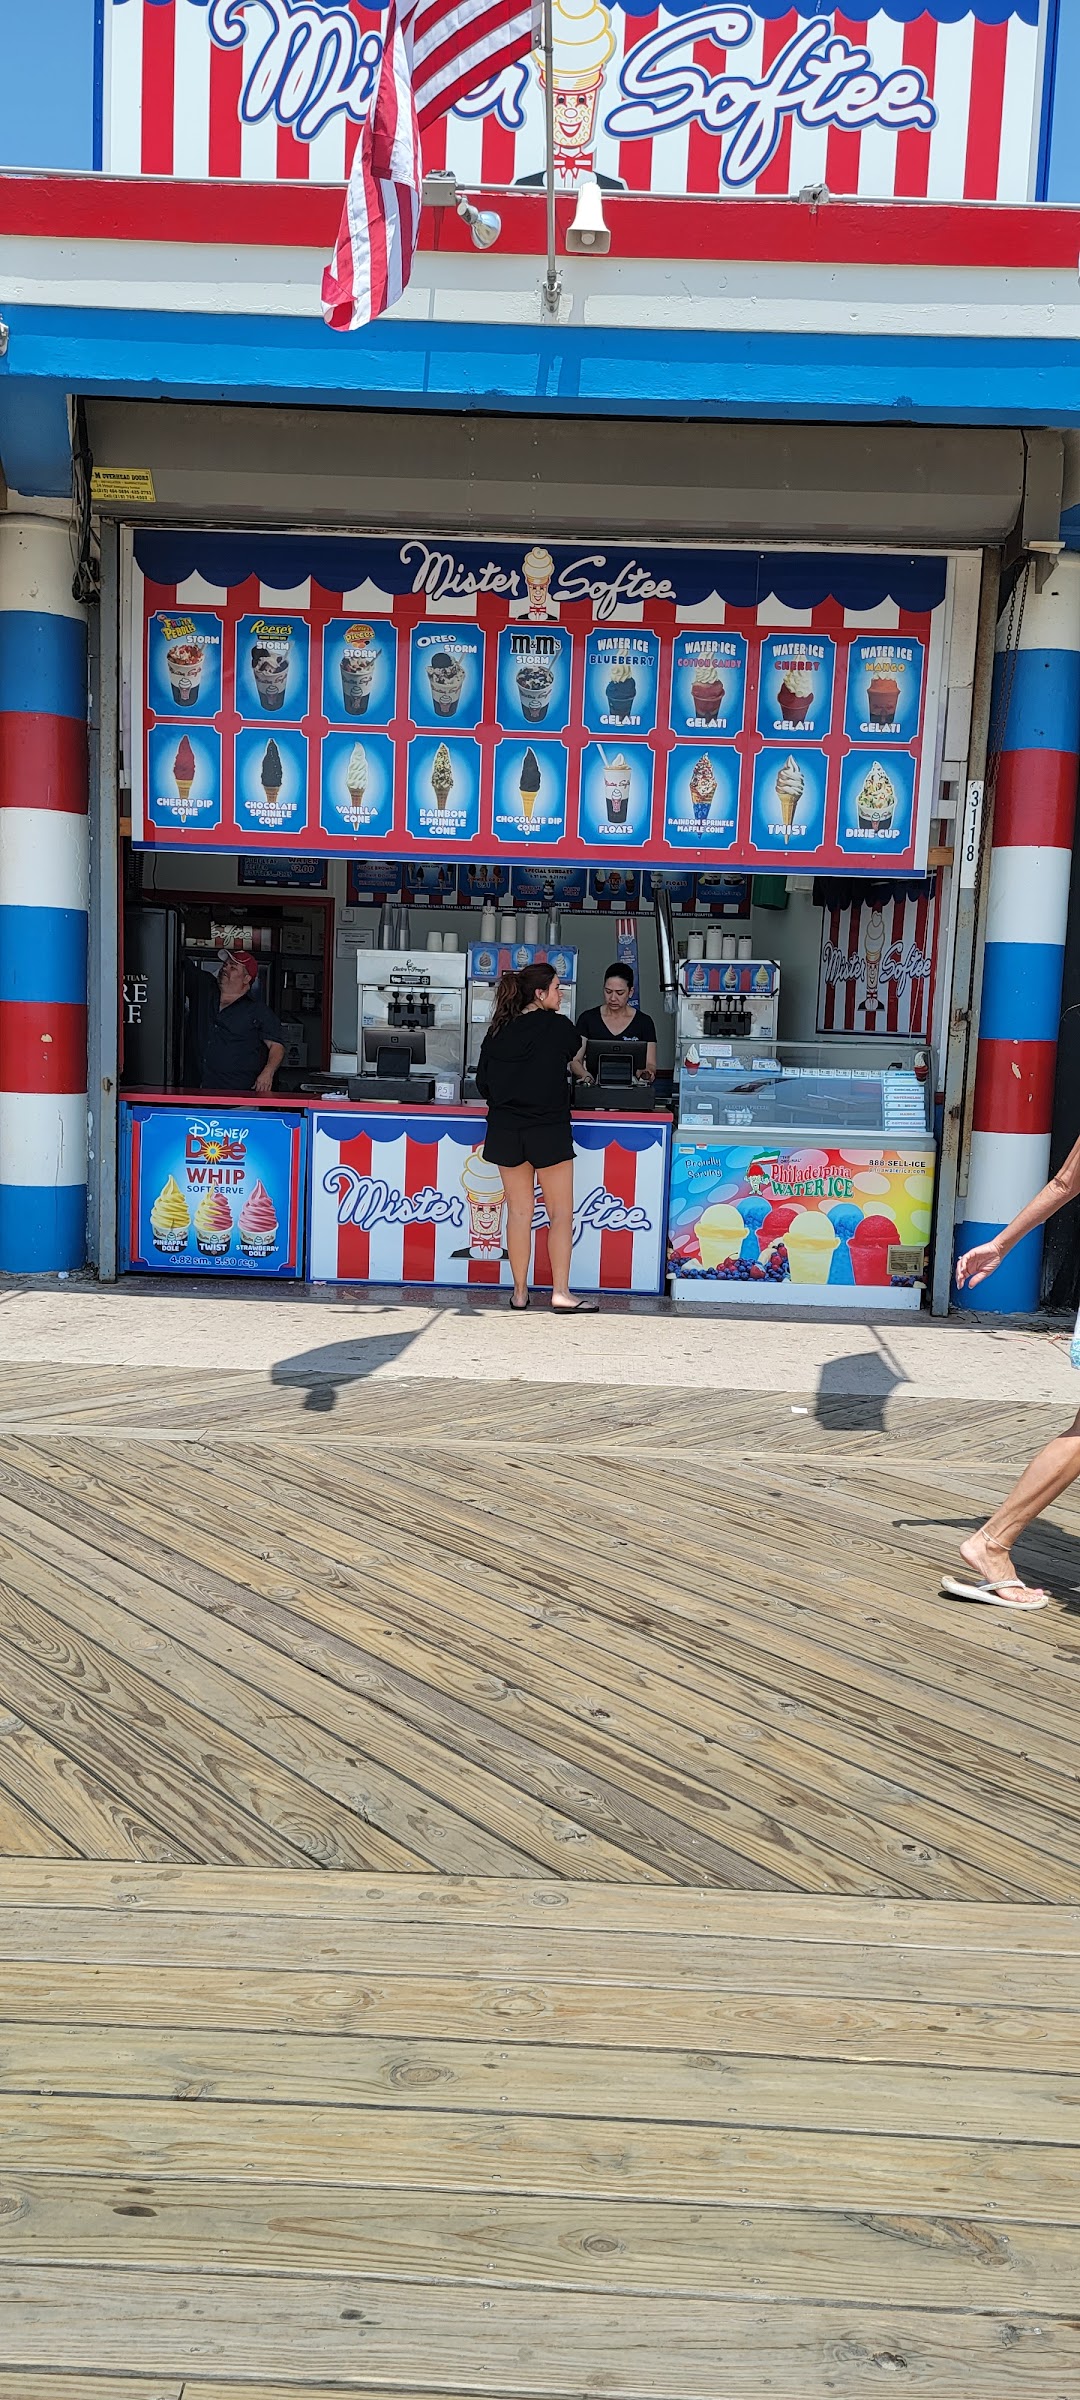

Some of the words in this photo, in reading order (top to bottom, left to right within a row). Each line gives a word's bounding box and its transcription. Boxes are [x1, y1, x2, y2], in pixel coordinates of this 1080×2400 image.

[602, 3, 939, 189] Softee
[400, 540, 520, 601] Mister
[552, 555, 677, 620] Softee
[165, 616, 193, 630] FRUITY
[162, 624, 197, 641] PEBBLES
[186, 635, 219, 644] STORM
[416, 634, 457, 647] OREO
[597, 637, 631, 651] WATER
[632, 639, 649, 653] ICE
[256, 641, 289, 650] STORM
[444, 644, 477, 653] STORM
[685, 641, 719, 655] WATER
[720, 642, 737, 656] ICE
[772, 643, 807, 657] WATER
[808, 644, 825, 658] ICE
[344, 649, 376, 658] STORM
[860, 646, 895, 660] WATER
[896, 647, 913, 661] ICE
[516, 656, 549, 665] STORM
[589, 654, 654, 666] BLUEBERRY
[677, 658, 711, 668] COTTON
[712, 659, 742, 669] CANDY
[774, 660, 821, 671] CHERRY
[865, 662, 906, 672] MANGO
[600, 715, 641, 726] GELATI
[686, 718, 727, 729] GELATI
[773, 720, 814, 731] GELATI
[859, 722, 901, 733] GELATI
[156, 797, 195, 808] CHERRY
[196, 799, 213, 809] DIP
[244, 801, 298, 811] CHOCOLATE
[171, 807, 199, 816] CONE
[250, 809, 292, 818] SPRINKLE
[335, 806, 379, 816] VANILLA
[419, 808, 467, 818] RAINBOW
[258, 817, 283, 826] CONE
[343, 814, 371, 824] CONE
[419, 817, 467, 827] SPRINKLE
[495, 815, 546, 825] CHOCOLATE
[547, 817, 563, 825] DIP
[668, 818, 701, 826] RAINBOW
[701, 819, 734, 827] SPRINKLE
[429, 826, 456, 835] CONE
[516, 823, 541, 832] CONE
[598, 825, 633, 834] FLOATS
[677, 825, 705, 833] WAFFLE
[705, 826, 725, 834] CONE
[767, 824, 808, 836] TWIST
[966, 790, 979, 862] 3118
[845, 828, 900, 839] DIXIE-CUP
[211, 924, 253, 947] Softee
[823, 940, 866, 988] Mister
[879, 940, 931, 998] Softee
[185, 1134, 247, 1161] Dole
[685, 1156, 721, 1168] Proudly
[186, 1167, 246, 1185] WHIP
[688, 1169, 722, 1179] Serving
[771, 1164, 852, 1183] Philadelphia
[187, 1185, 212, 1194] SOFT
[214, 1186, 244, 1195] SERVE
[771, 1178, 824, 1196] WATER
[827, 1177, 853, 1198] ICE
[323, 1164, 464, 1231] Mister
[153, 1239, 188, 1247] PINEAPPLE
[199, 1243, 227, 1252] TWIST
[235, 1245, 279, 1253] STRAWBERRY
[169, 1256, 191, 1265] 4.82
[214, 1257, 236, 1266] 5.50
